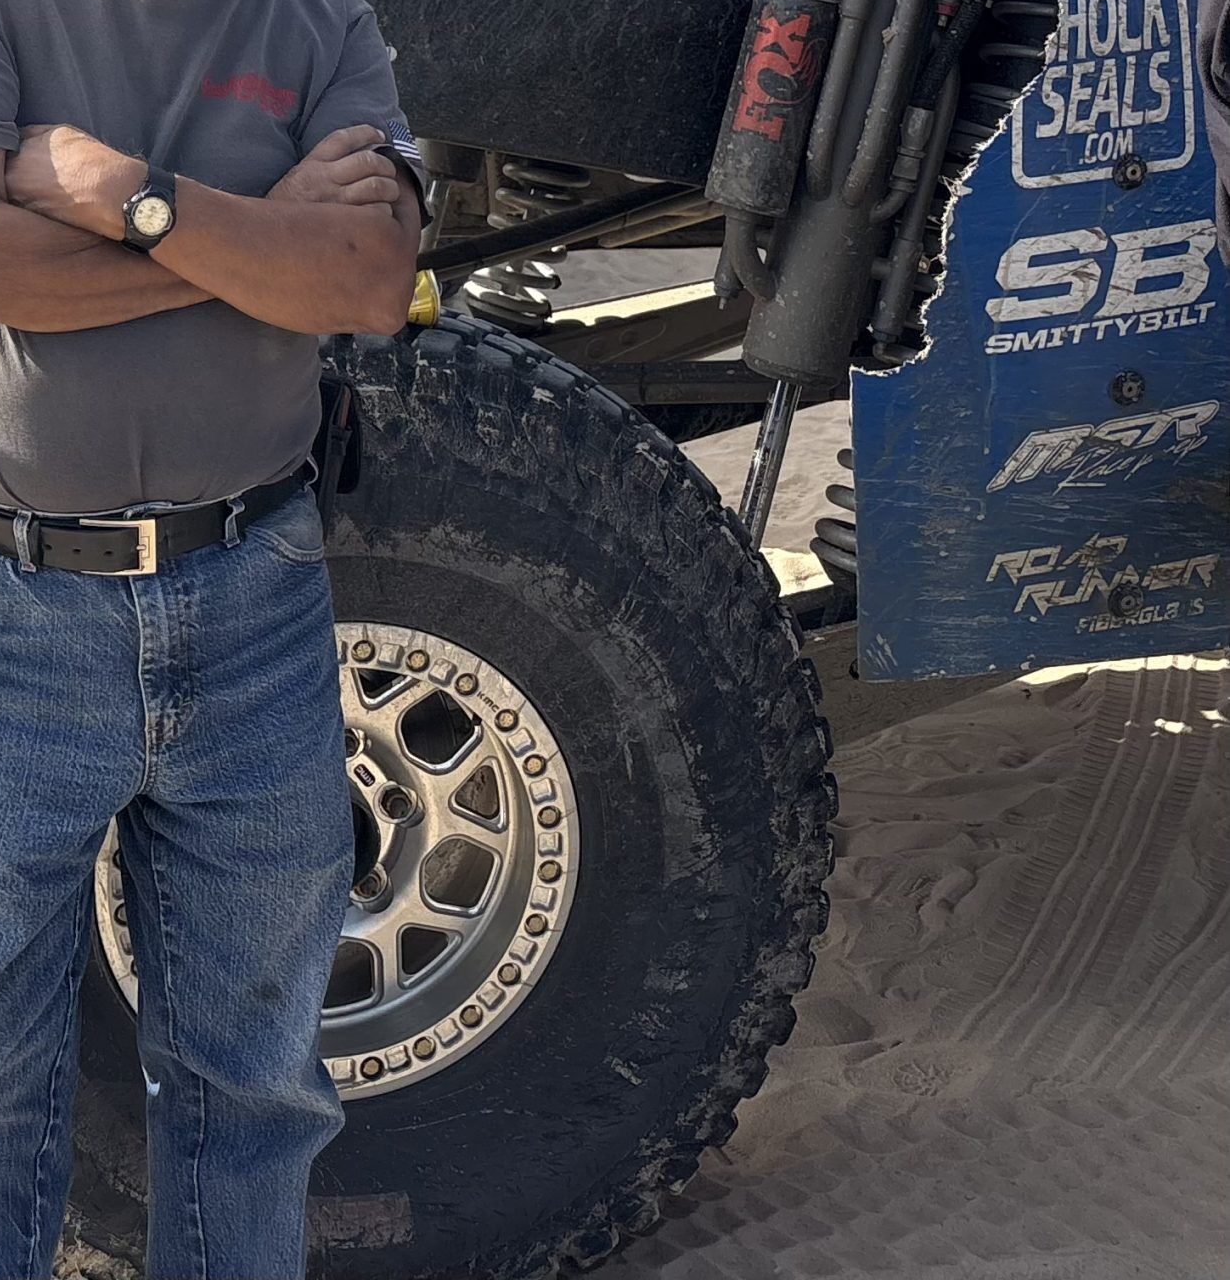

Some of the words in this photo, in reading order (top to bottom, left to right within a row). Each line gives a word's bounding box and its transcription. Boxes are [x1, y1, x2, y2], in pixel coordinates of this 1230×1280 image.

[733, 4, 811, 142] FOX
[1036, 51, 1171, 138] SEALS
[1079, 128, 1134, 165] .COM
[984, 218, 1217, 323] SB
[984, 301, 1217, 355] SMITTYBILT
[986, 532, 1129, 585] ROAD
[1074, 598, 1205, 634] FIBGLAS
